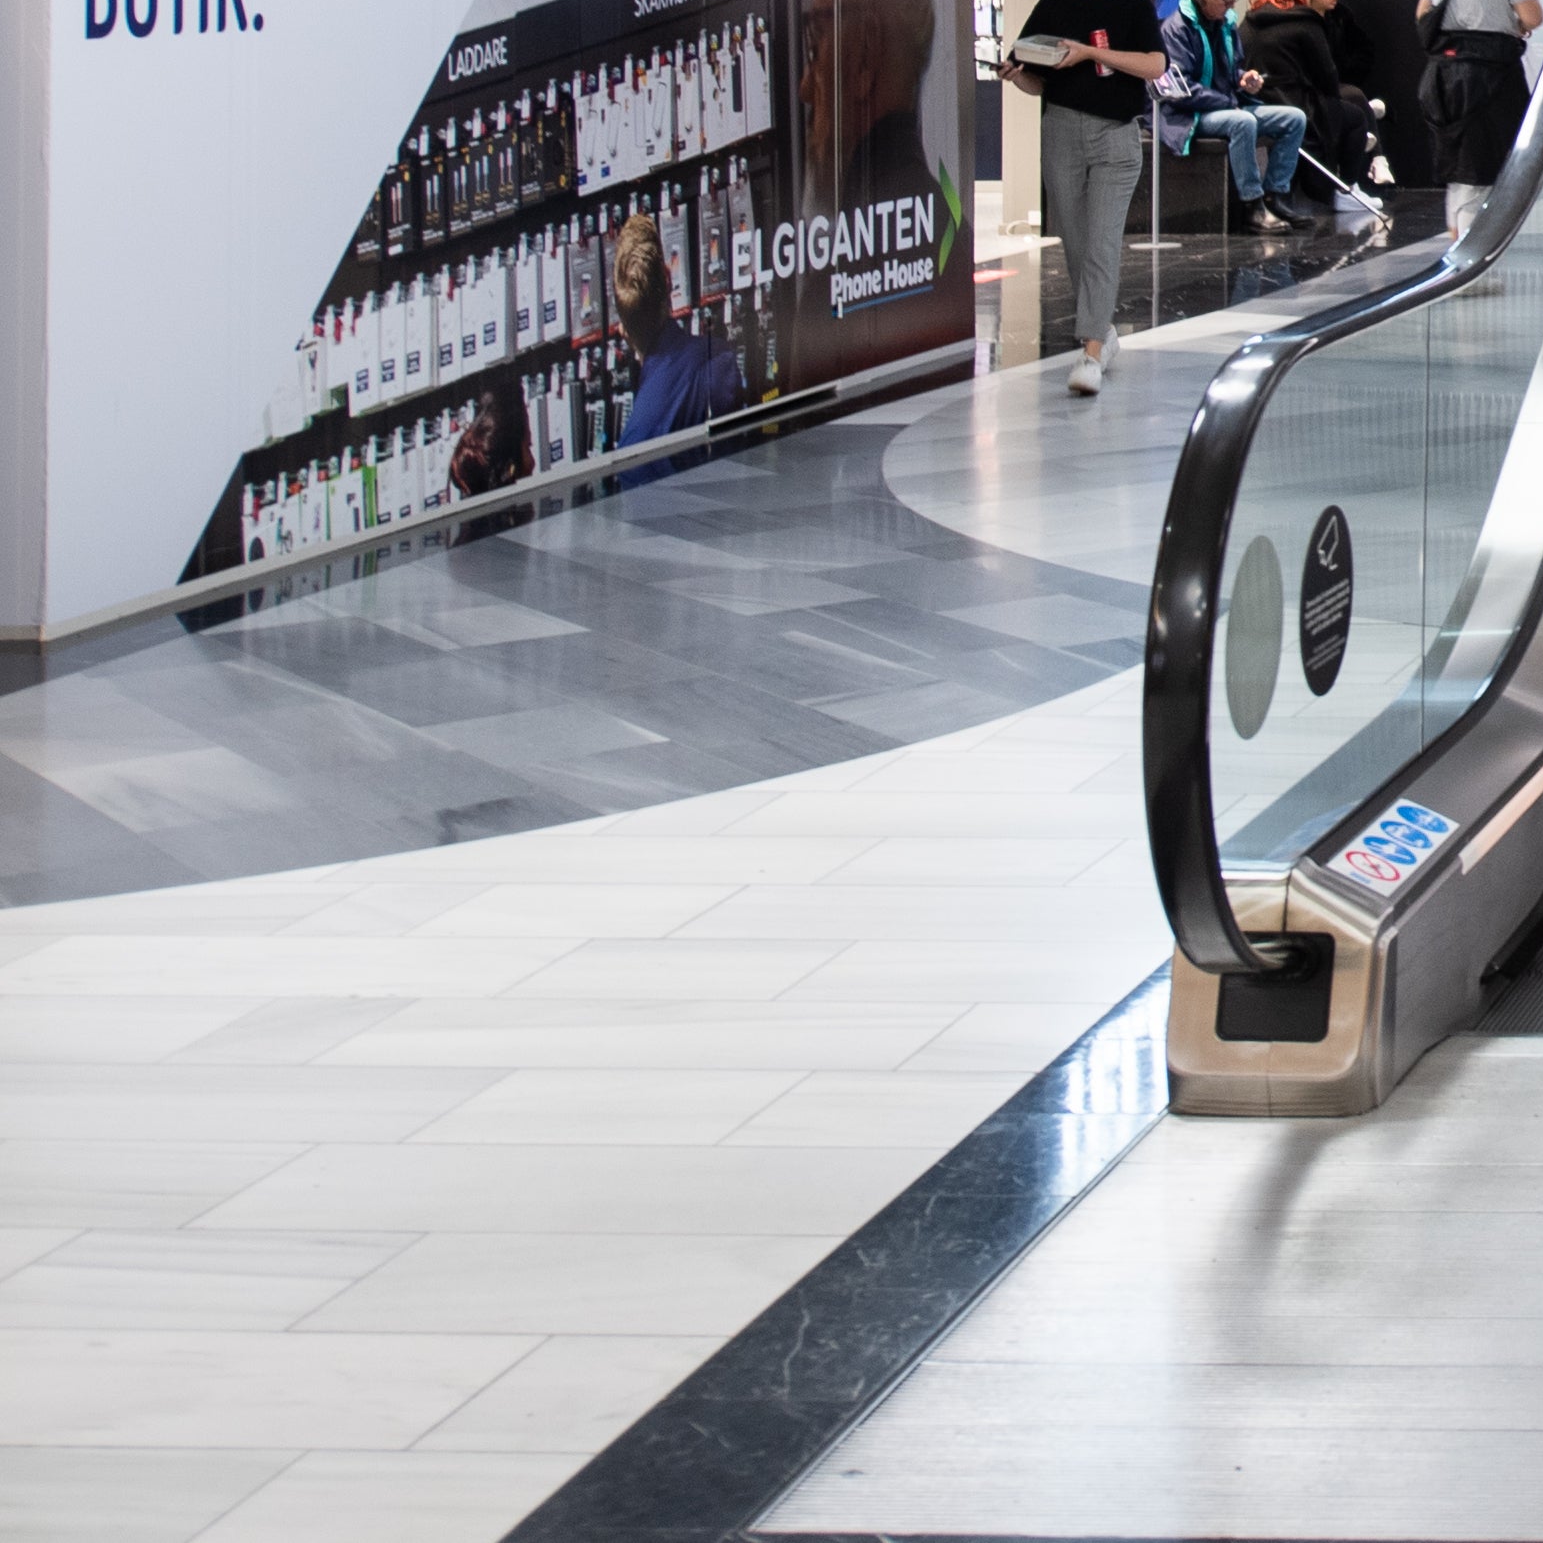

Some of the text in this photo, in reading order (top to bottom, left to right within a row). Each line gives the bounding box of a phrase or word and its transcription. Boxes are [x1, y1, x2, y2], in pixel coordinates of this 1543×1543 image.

[447, 36, 508, 82] LADDARE
[732, 193, 935, 290] ELGIGANTEN
[831, 257, 934, 305] Phone House
